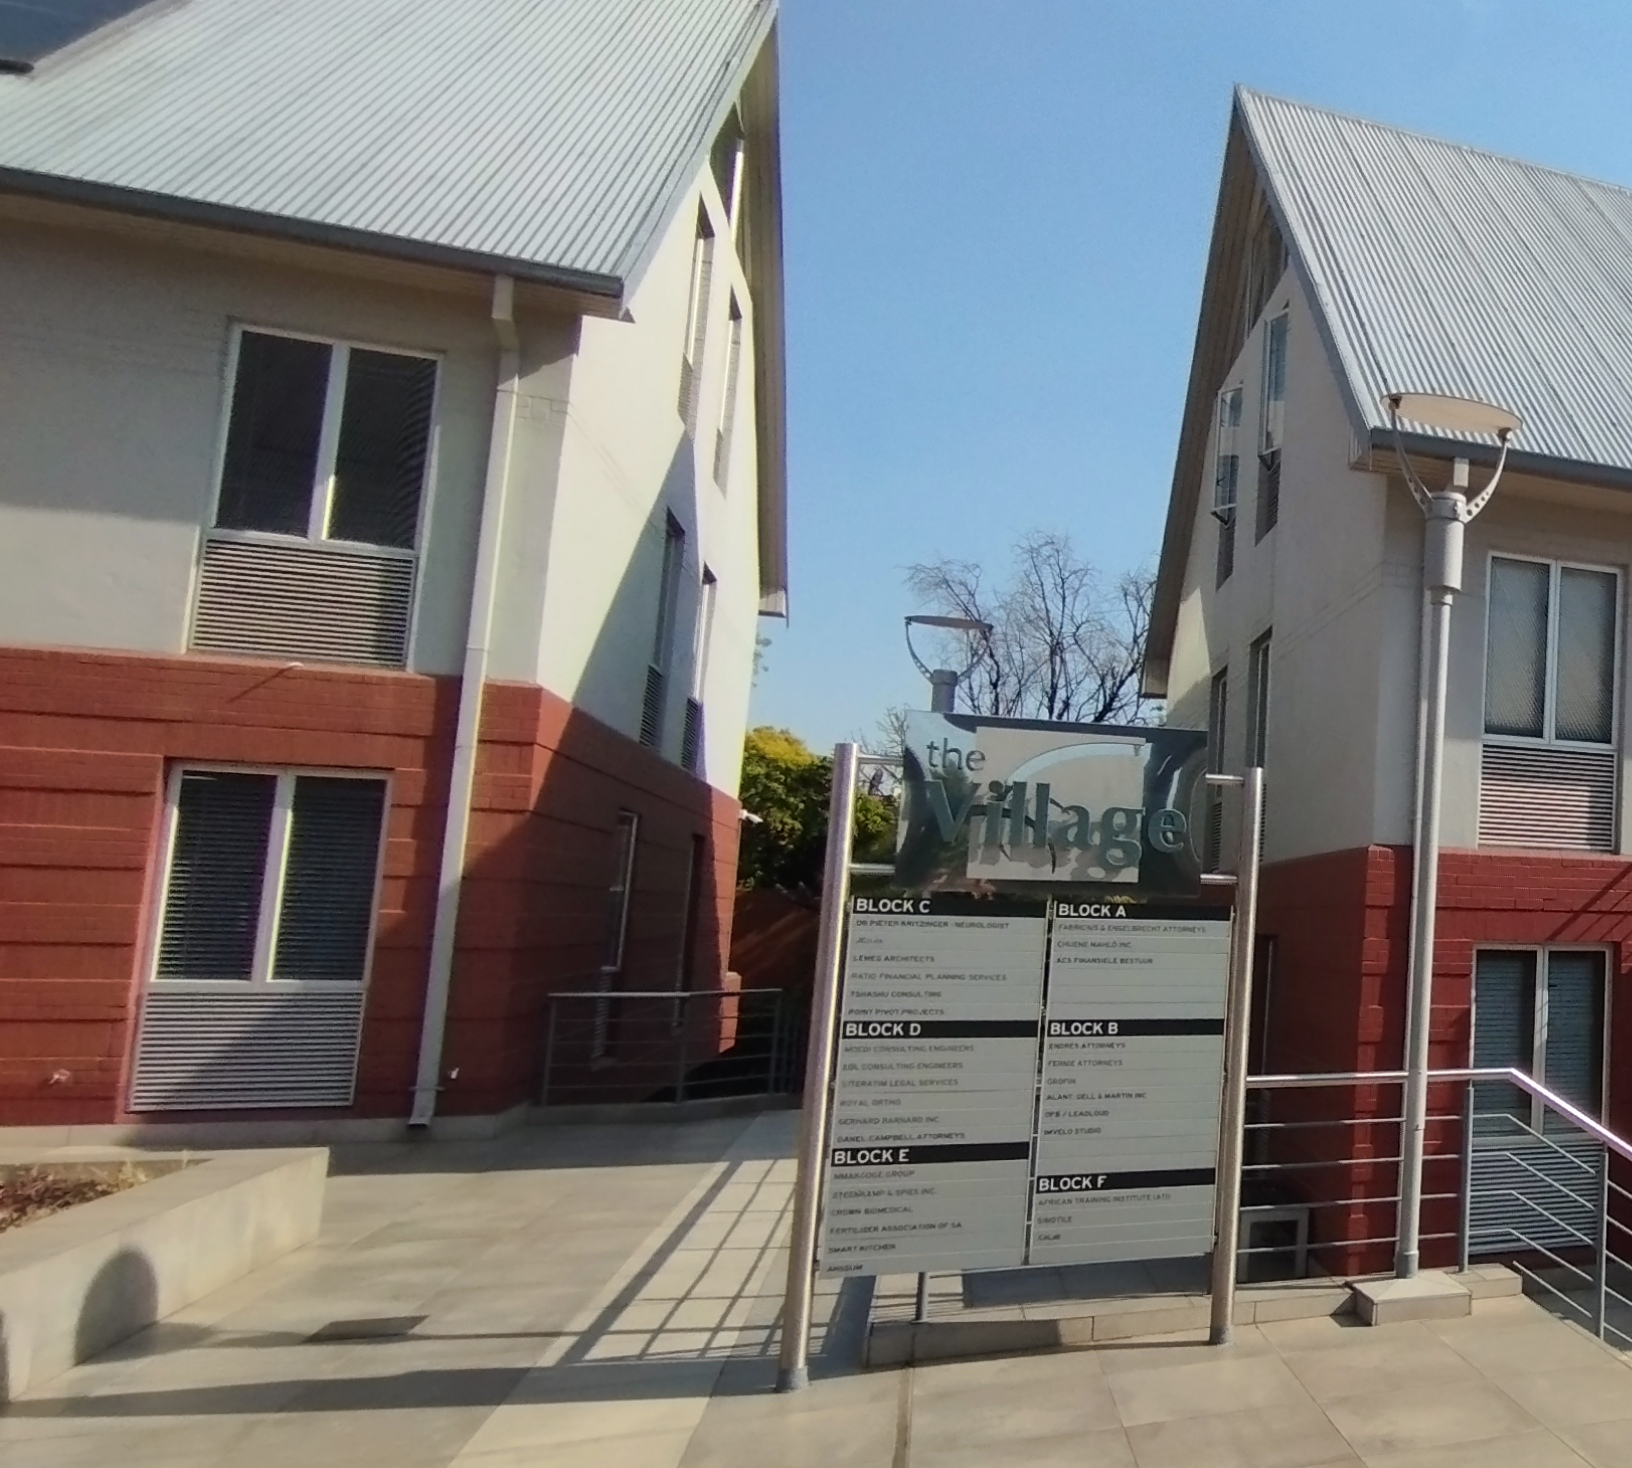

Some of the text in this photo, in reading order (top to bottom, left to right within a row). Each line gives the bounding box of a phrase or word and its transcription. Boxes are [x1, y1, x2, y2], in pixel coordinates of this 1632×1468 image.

[926, 737, 986, 771] the
[924, 780, 1187, 867] Village
[856, 898, 931, 913] BLOCK C
[1058, 904, 1127, 918] BLOCK A
[954, 922, 1010, 930] NEUROLOGIST
[1163, 926, 1206, 934] ATTORNEYS
[883, 955, 935, 963] ARCHITECTS
[1119, 957, 1154, 965] BESTUUR
[878, 973, 921, 981] FINANCIAL
[925, 973, 965, 981] PLANNING
[890, 990, 942, 998] CONSULTING
[875, 1008, 900, 1016] PIVOT
[900, 1008, 945, 1016] PROJECTS
[845, 1023, 921, 1037] BLOCK D
[1050, 1022, 1119, 1035] BLOCK B
[873, 1045, 927, 1053] CONSULTING
[928, 1044, 975, 1052] ENGINEERS
[861, 1063, 916, 1071] CONSULTING
[916, 1062, 964, 1070] ENGINEERS
[1077, 1059, 1124, 1067] ATTORNEYS
[889, 1079, 917, 1087] LEGAL
[918, 1078, 959, 1087] SERVICES
[1074, 1127, 1102, 1135] STUDIO
[868, 1134, 916, 1142] CAMPBELL
[916, 1132, 966, 1140] ATTORNEYS
[834, 1149, 910, 1165] BLOCK E
[885, 1170, 915, 1178] GROUP
[1038, 1175, 1107, 1192] BLOCK F
[895, 1188, 919, 1197] SPIES
[920, 1188, 936, 1196] INC
[1038, 1198, 1073, 1206] AFRICAN
[1074, 1196, 1111, 1204] TRAINING
[1112, 1194, 1151, 1202] INSTITUTE
[863, 1206, 914, 1215] BIOMEDICAL
[880, 1223, 936, 1232] ASSOCIATION
[937, 1222, 949, 1230] OF
[828, 1244, 896, 1254] SMART KITCHEN
